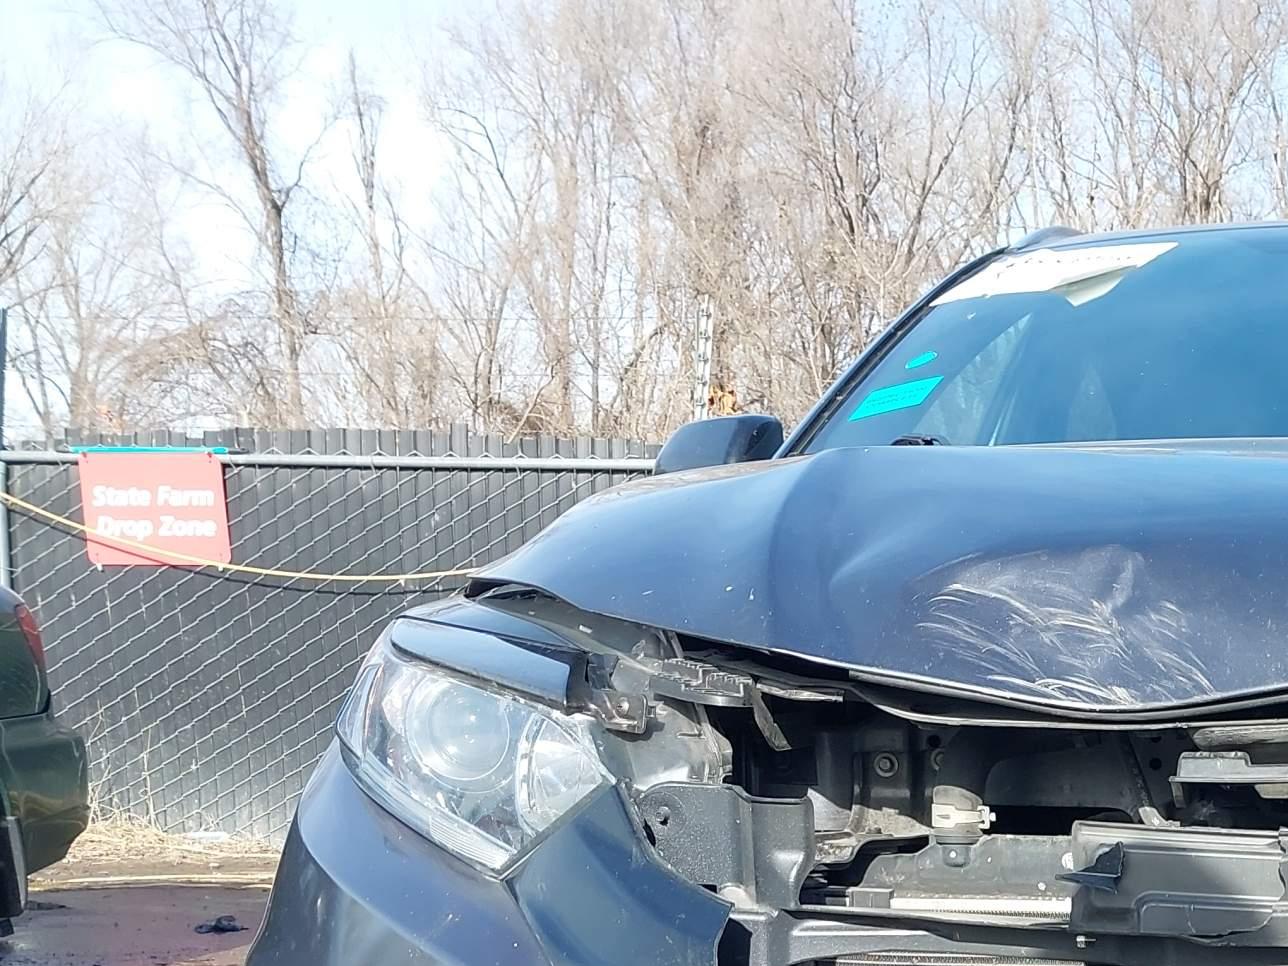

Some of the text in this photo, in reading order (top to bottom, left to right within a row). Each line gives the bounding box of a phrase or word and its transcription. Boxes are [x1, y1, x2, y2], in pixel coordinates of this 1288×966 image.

[92, 485, 215, 507] State Farm
[97, 515, 216, 541] Drop Zone
